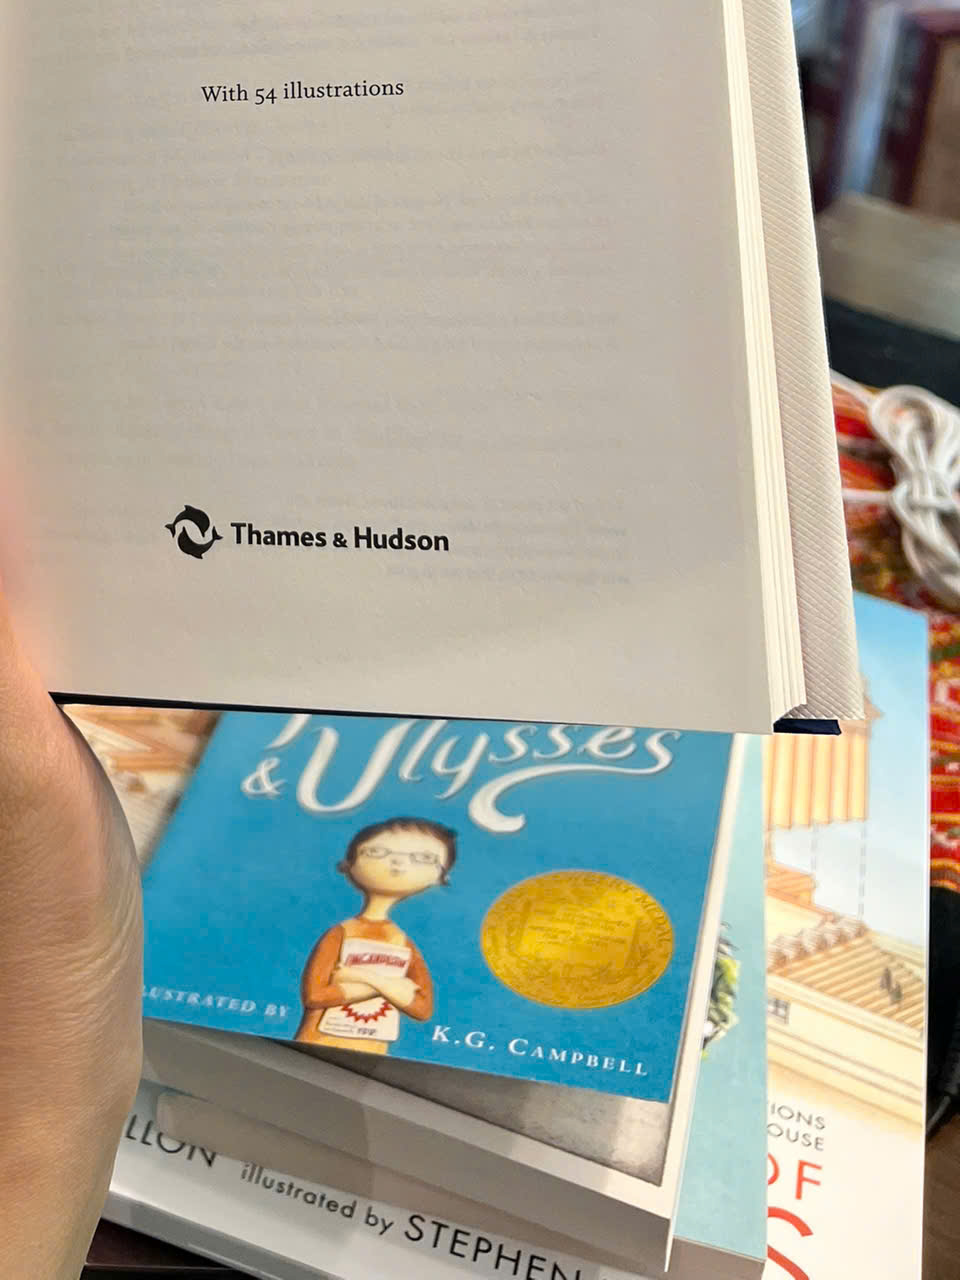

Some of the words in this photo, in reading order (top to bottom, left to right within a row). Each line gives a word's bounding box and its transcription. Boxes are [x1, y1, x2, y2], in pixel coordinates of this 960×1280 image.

[201, 84, 248, 102] With
[255, 89, 277, 105] 54
[284, 81, 403, 99] illustrations
[231, 523, 326, 547] Thames
[333, 533, 347, 548] &
[354, 526, 449, 551] Hudson
[242, 757, 286, 797] &
[297, 718, 681, 833] Ulysses
[264, 1002, 289, 1018] BY
[431, 1024, 496, 1051] K.G.
[508, 1037, 649, 1077] CAMPBELL
[768, 1102, 826, 1131] IONS
[240, 1163, 356, 1220] illustrated
[364, 1206, 394, 1236] by
